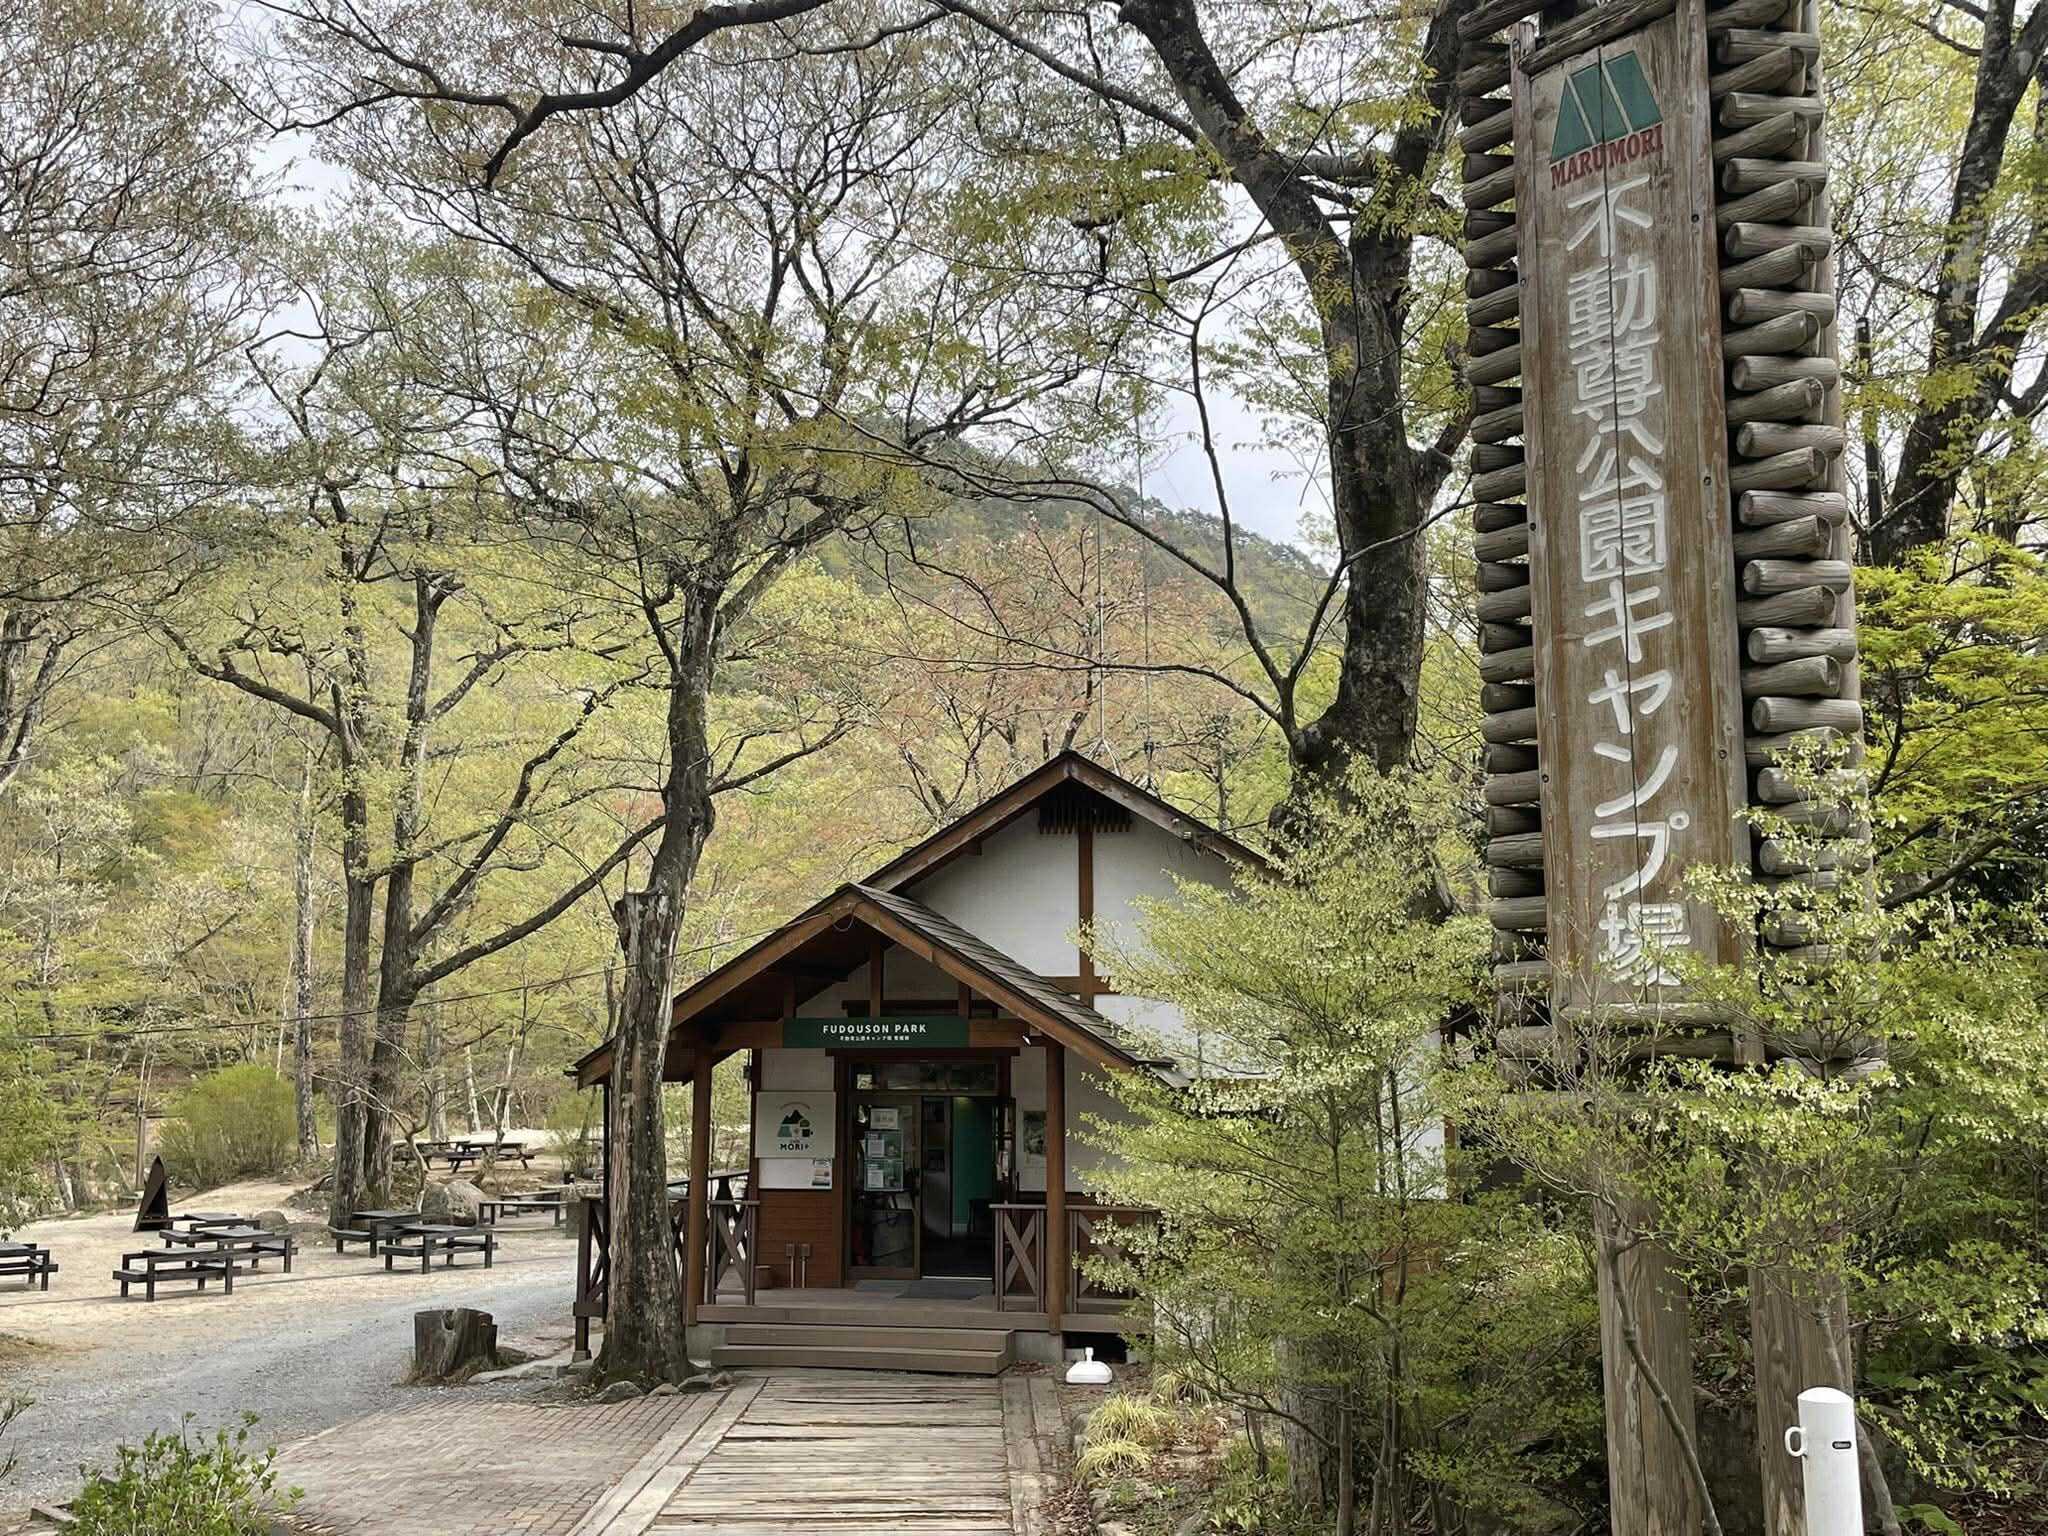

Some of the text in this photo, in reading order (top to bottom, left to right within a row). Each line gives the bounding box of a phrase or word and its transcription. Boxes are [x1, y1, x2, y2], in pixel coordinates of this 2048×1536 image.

[1550, 124, 1664, 191] MARUMORI
[1567, 174, 1692, 988] 不動尊公園キャンプ場
[823, 1023, 927, 1034] FUDOUSON PARK
